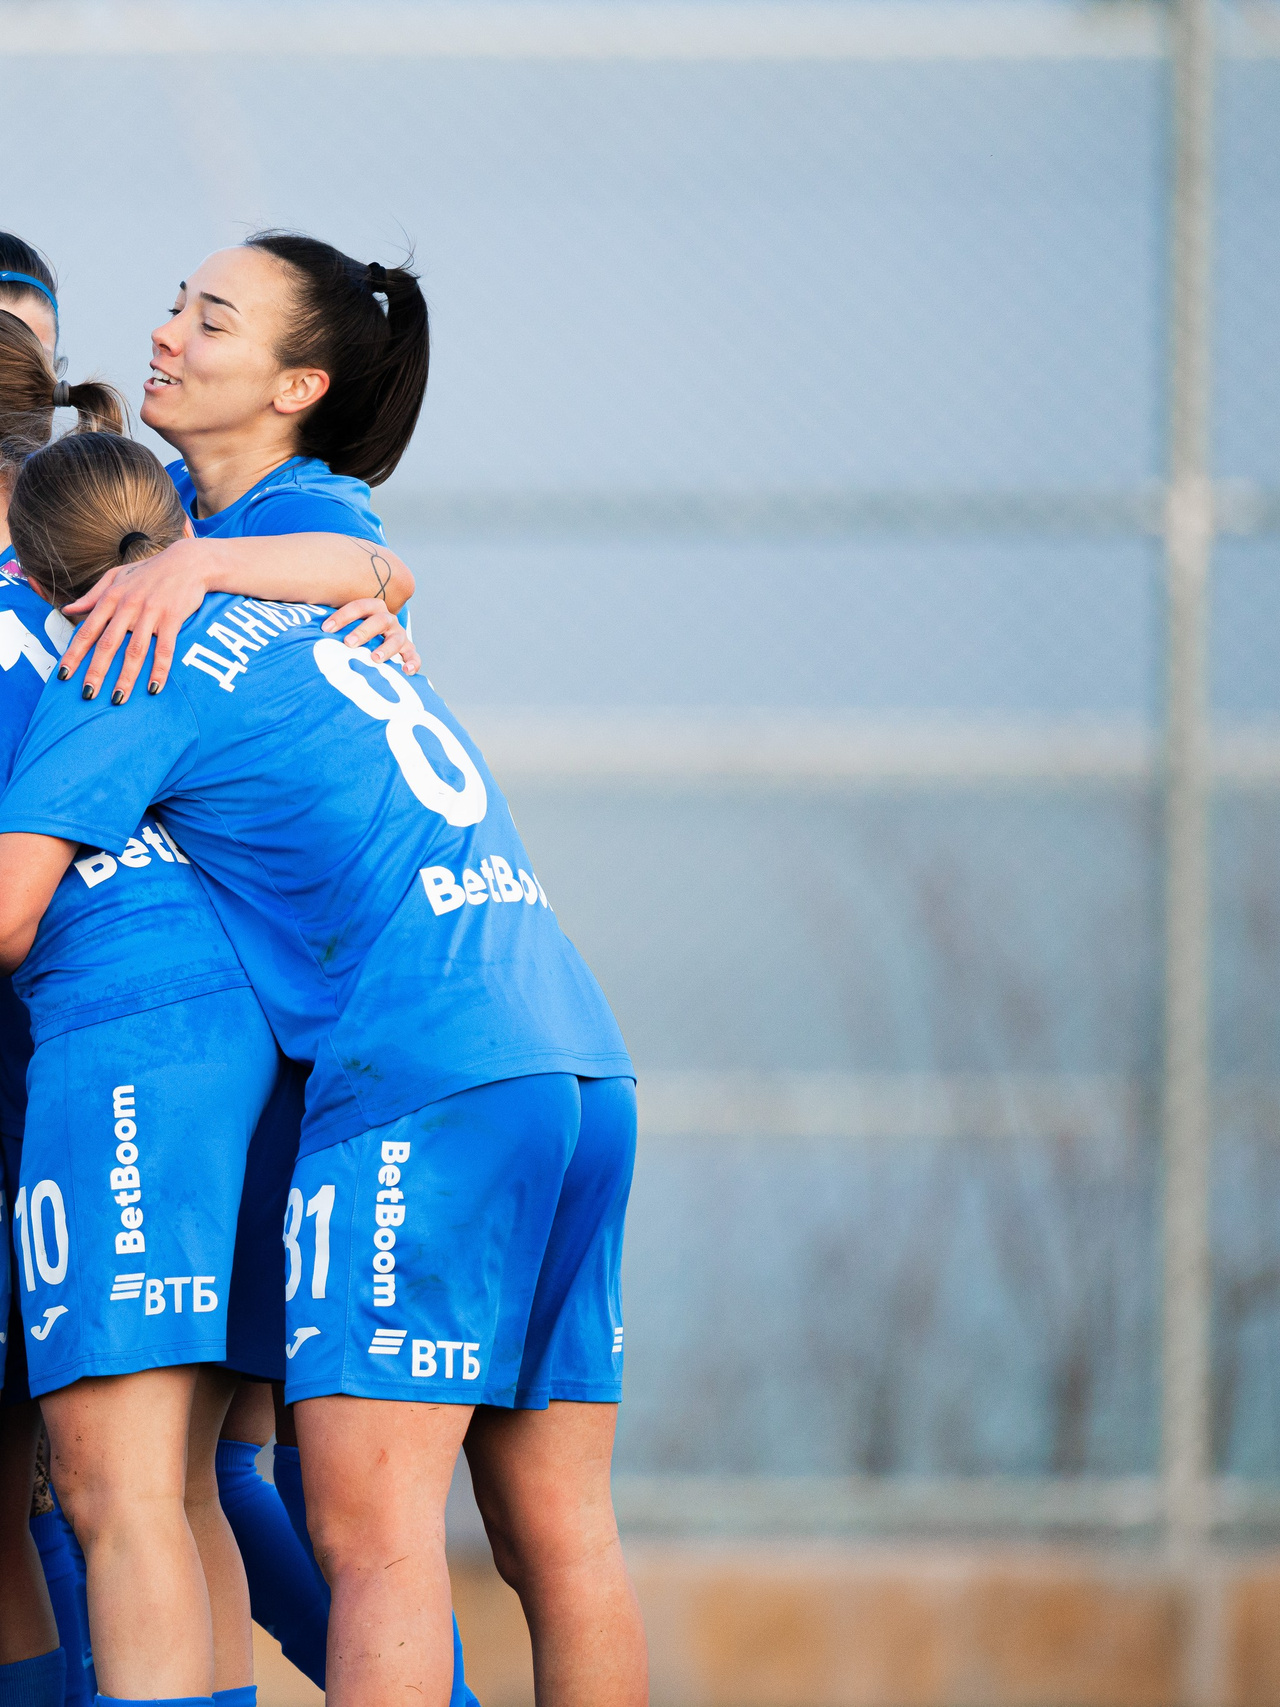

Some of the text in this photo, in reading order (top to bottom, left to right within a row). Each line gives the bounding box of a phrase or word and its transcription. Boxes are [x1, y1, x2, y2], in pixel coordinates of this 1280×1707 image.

[313, 638, 487, 828] 8
[419, 855, 554, 916] BetBo
[110, 1085, 146, 1255] BetBoom
[372, 1141, 411, 1307] BetBoom
[15, 1179, 69, 1292] 10
[145, 1276, 219, 1316] ВТБ
[412, 1339, 481, 1380] ВТБ
